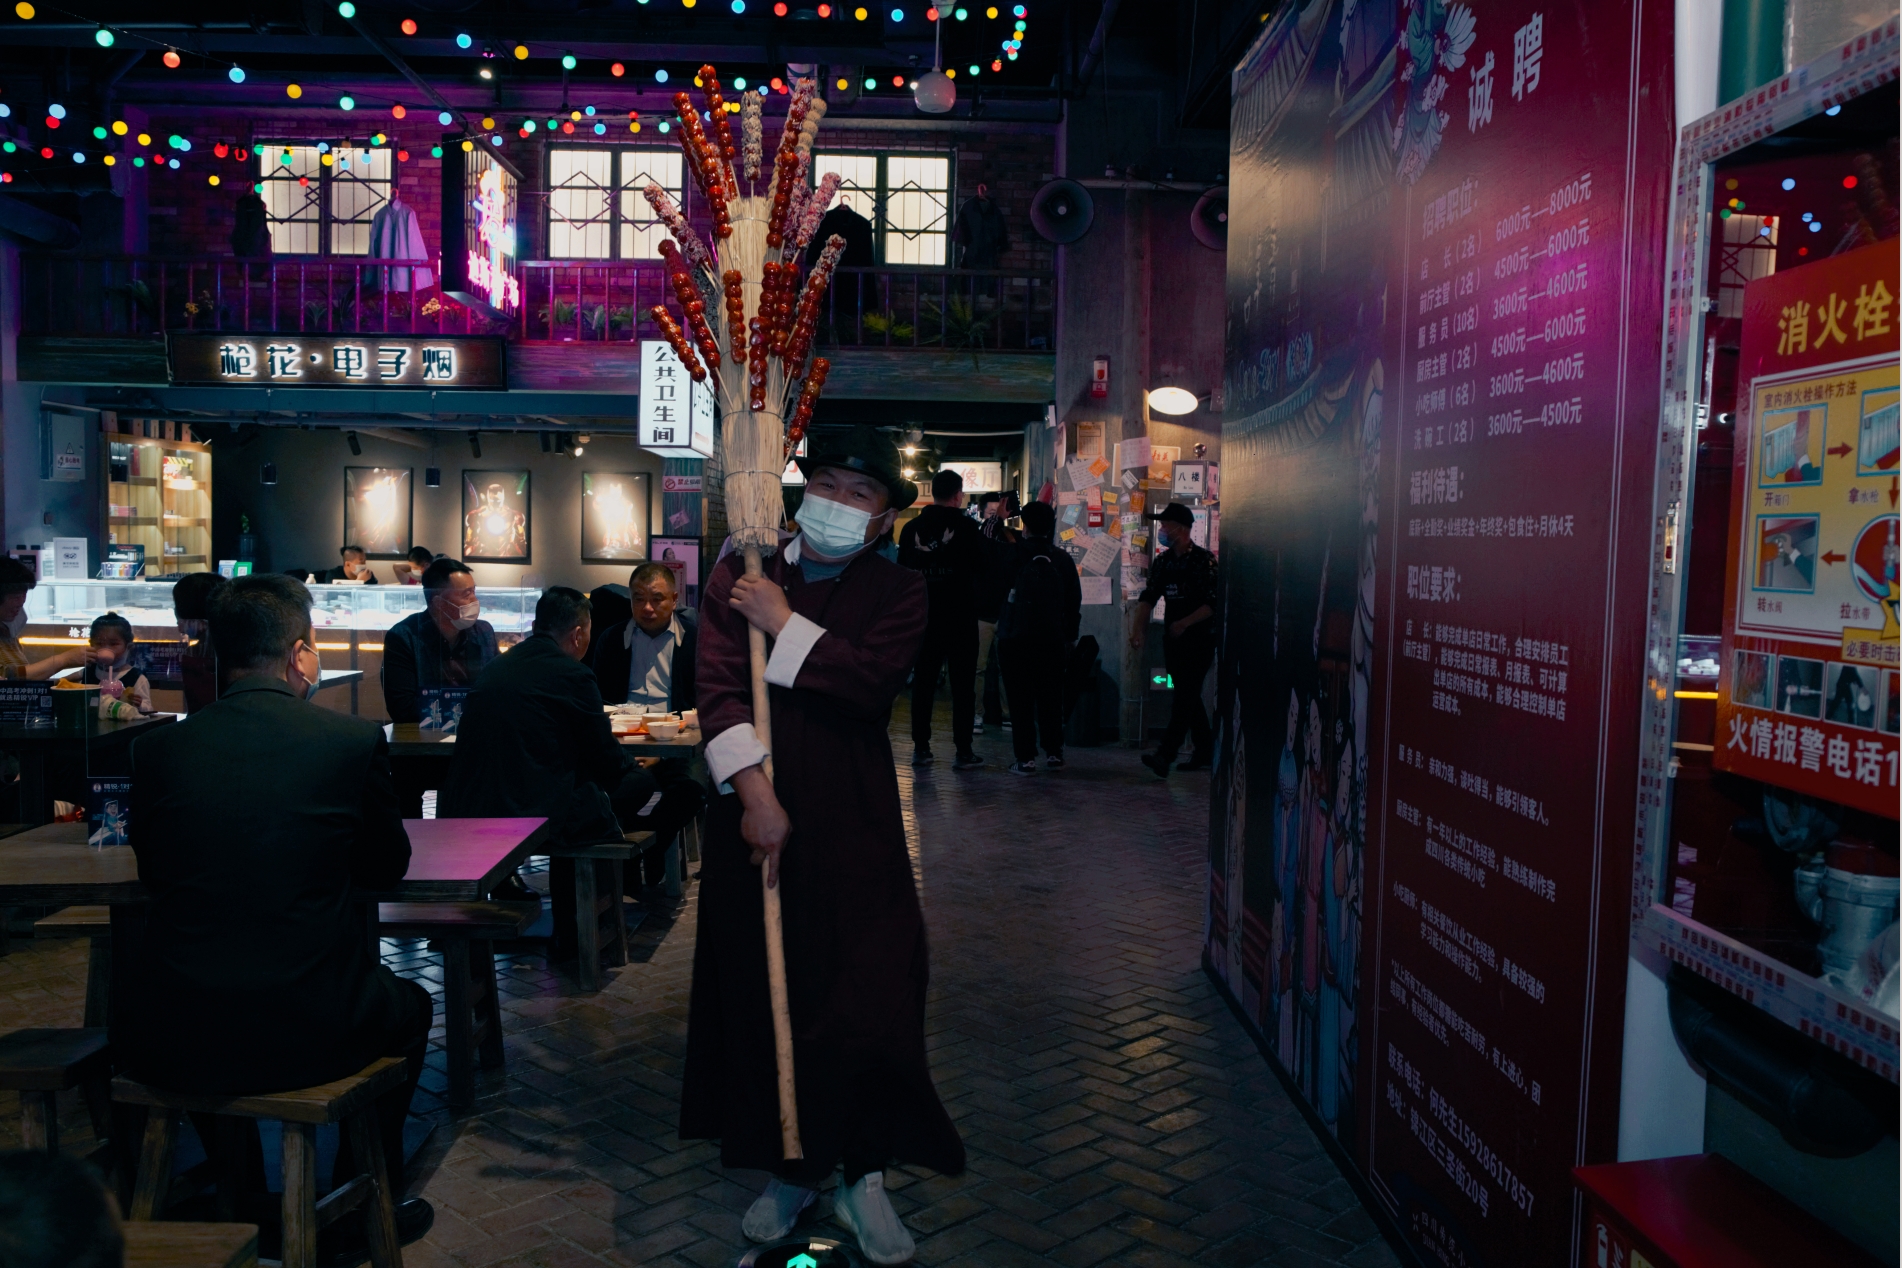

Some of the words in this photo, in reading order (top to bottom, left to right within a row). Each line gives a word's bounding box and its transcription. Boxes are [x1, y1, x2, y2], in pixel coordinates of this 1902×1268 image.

[1468, 11, 1544, 134] 诚聘
[1777, 279, 1900, 356] 消火栓
[219, 343, 457, 381] 枪花·电子烟
[652, 345, 677, 444] 公共卫生间
[1764, 380, 1857, 408] 室内消火栓操作方法
[1178, 471, 1199, 482] 八楼
[1848, 487, 1879, 504] 拿水枪
[1840, 602, 1871, 620] 拉水带
[1846, 640, 1900, 662] 必要时击
[1727, 713, 1899, 787] 火情报警电话1
